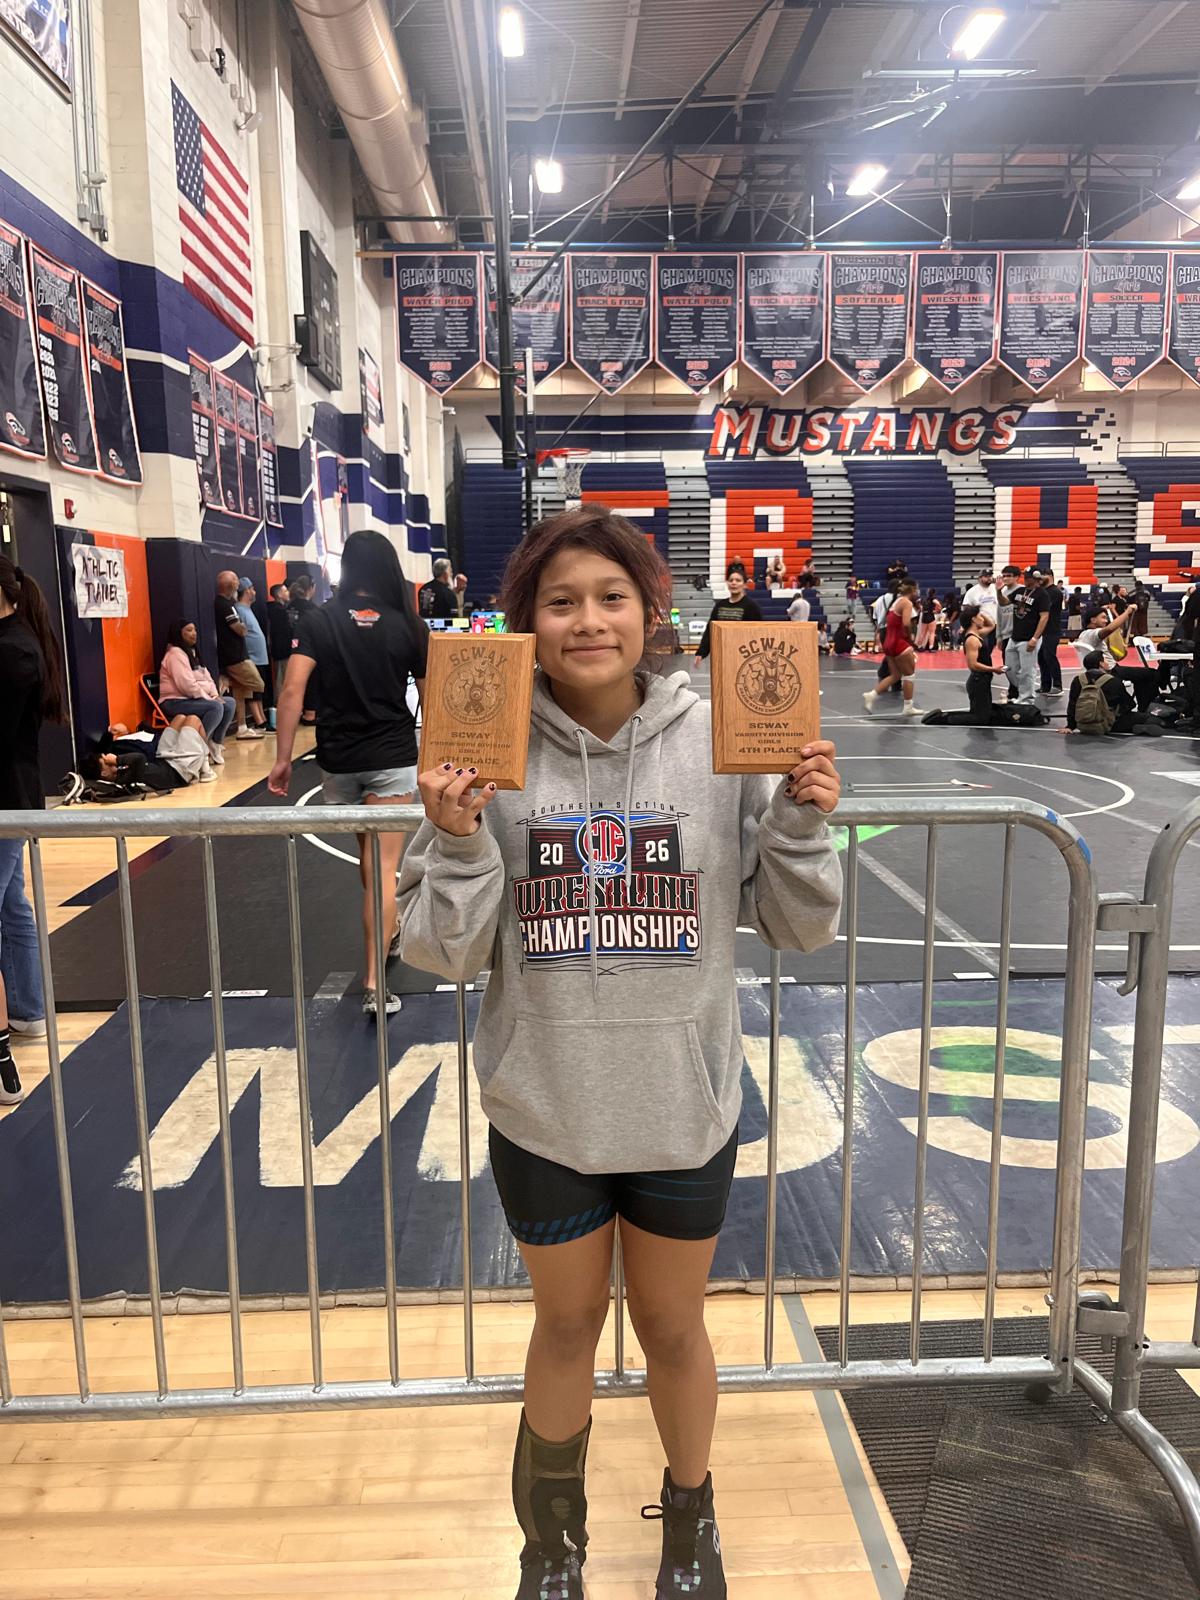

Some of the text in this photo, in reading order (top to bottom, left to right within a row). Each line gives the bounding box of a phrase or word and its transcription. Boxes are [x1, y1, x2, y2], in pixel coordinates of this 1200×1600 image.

[400, 268, 475, 290] CHAMPIONS
[575, 268, 648, 290] CHAMPIONS
[661, 268, 734, 290] CHAMPIONS
[748, 267, 819, 290] CHAMPIONS
[834, 266, 907, 289] CHAMPIONS
[920, 266, 993, 288] CHAMPIONS
[1007, 265, 1078, 287] CHAMPIONS
[1092, 265, 1163, 286] CHAMPIONS
[406, 298, 470, 306] WATER POLO
[579, 298, 608, 306] TRACK
[620, 298, 644, 306] FIELD
[667, 298, 728, 306] WATER POLO
[842, 296, 896, 304] SOFTBALL
[927, 295, 984, 303] WRESTLING
[1013, 295, 1071, 303] WRESTLING
[1109, 294, 1143, 302] SOCCER
[705, 404, 1023, 458] MUSTANGS
[449, 646, 508, 668] SCWAY
[738, 637, 799, 659] SCWAY
[450, 731, 490, 739] SCWAY
[462, 756, 500, 765] PLACE
[738, 746, 801, 754] 4TH PLACE
[616, 801, 675, 812] SCTION
[540, 839, 670, 865] 20 26
[582, 820, 625, 863] CIF
[593, 863, 619, 876] Ford
[515, 872, 696, 917] WRESTLING
